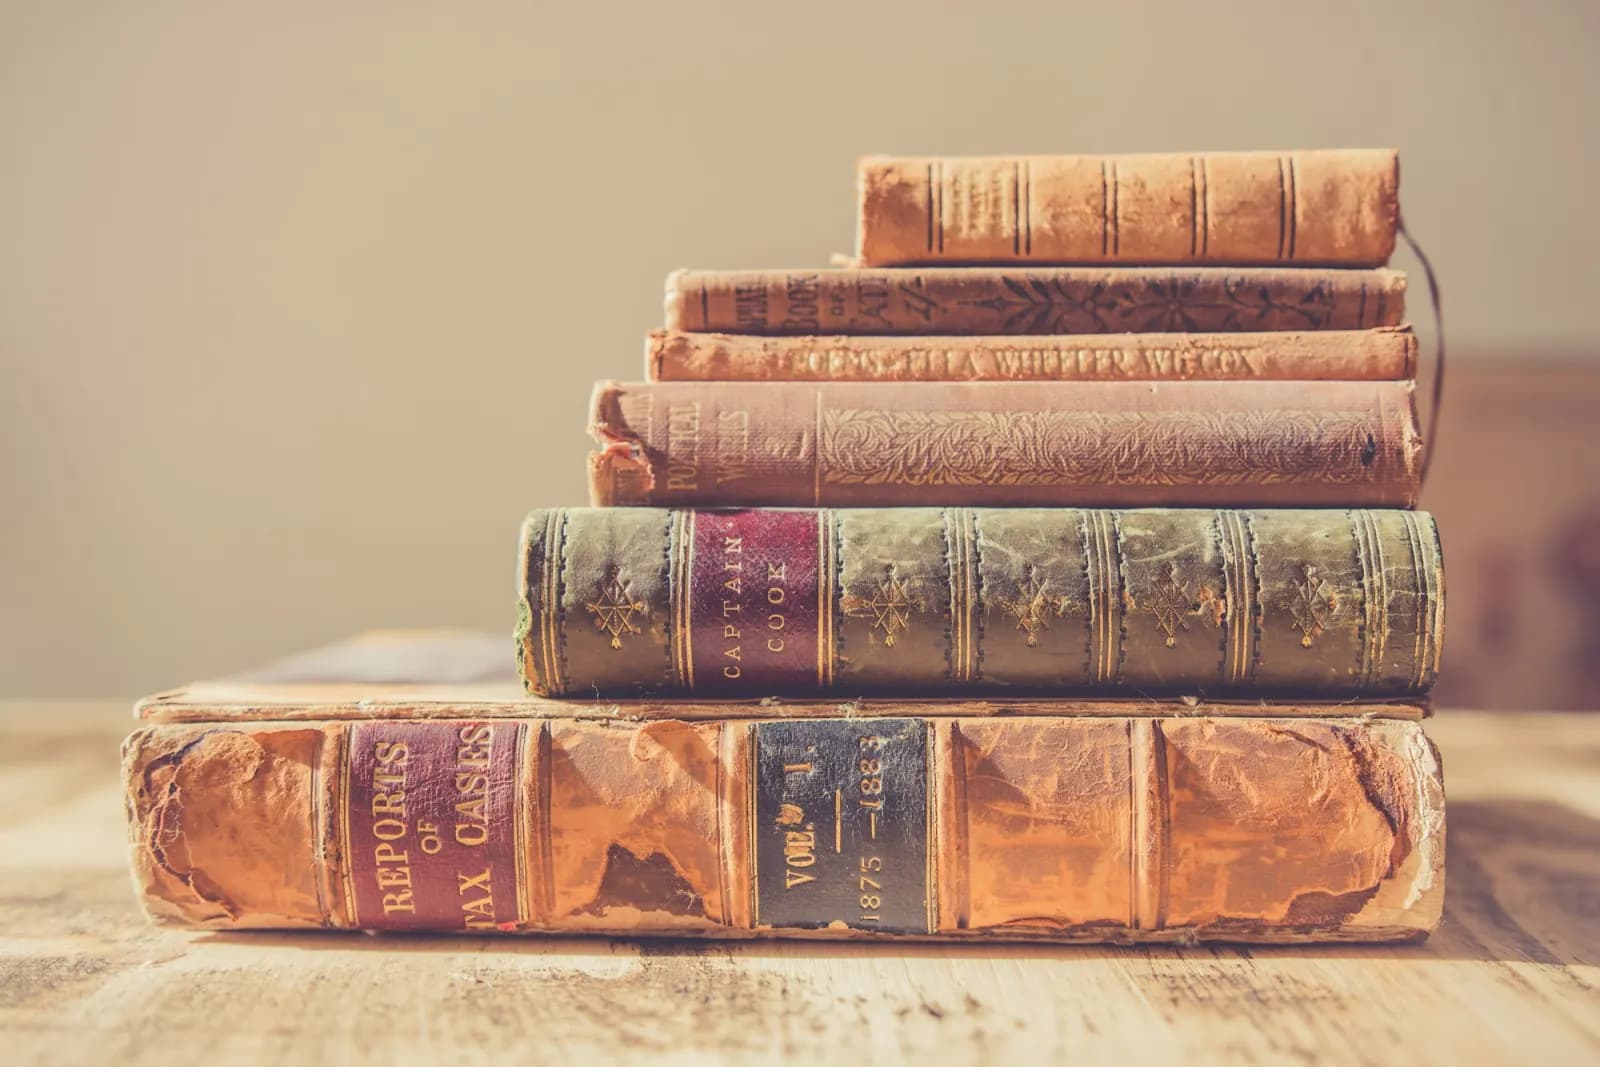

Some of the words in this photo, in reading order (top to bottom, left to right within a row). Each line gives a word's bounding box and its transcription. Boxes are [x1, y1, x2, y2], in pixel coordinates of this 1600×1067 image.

[724, 536, 742, 679] CAPTAIN
[768, 562, 785, 652] COOK
[372, 742, 416, 915] REPORTS
[417, 818, 442, 854] OF
[455, 724, 494, 846] CASES
[458, 867, 495, 929] TAX
